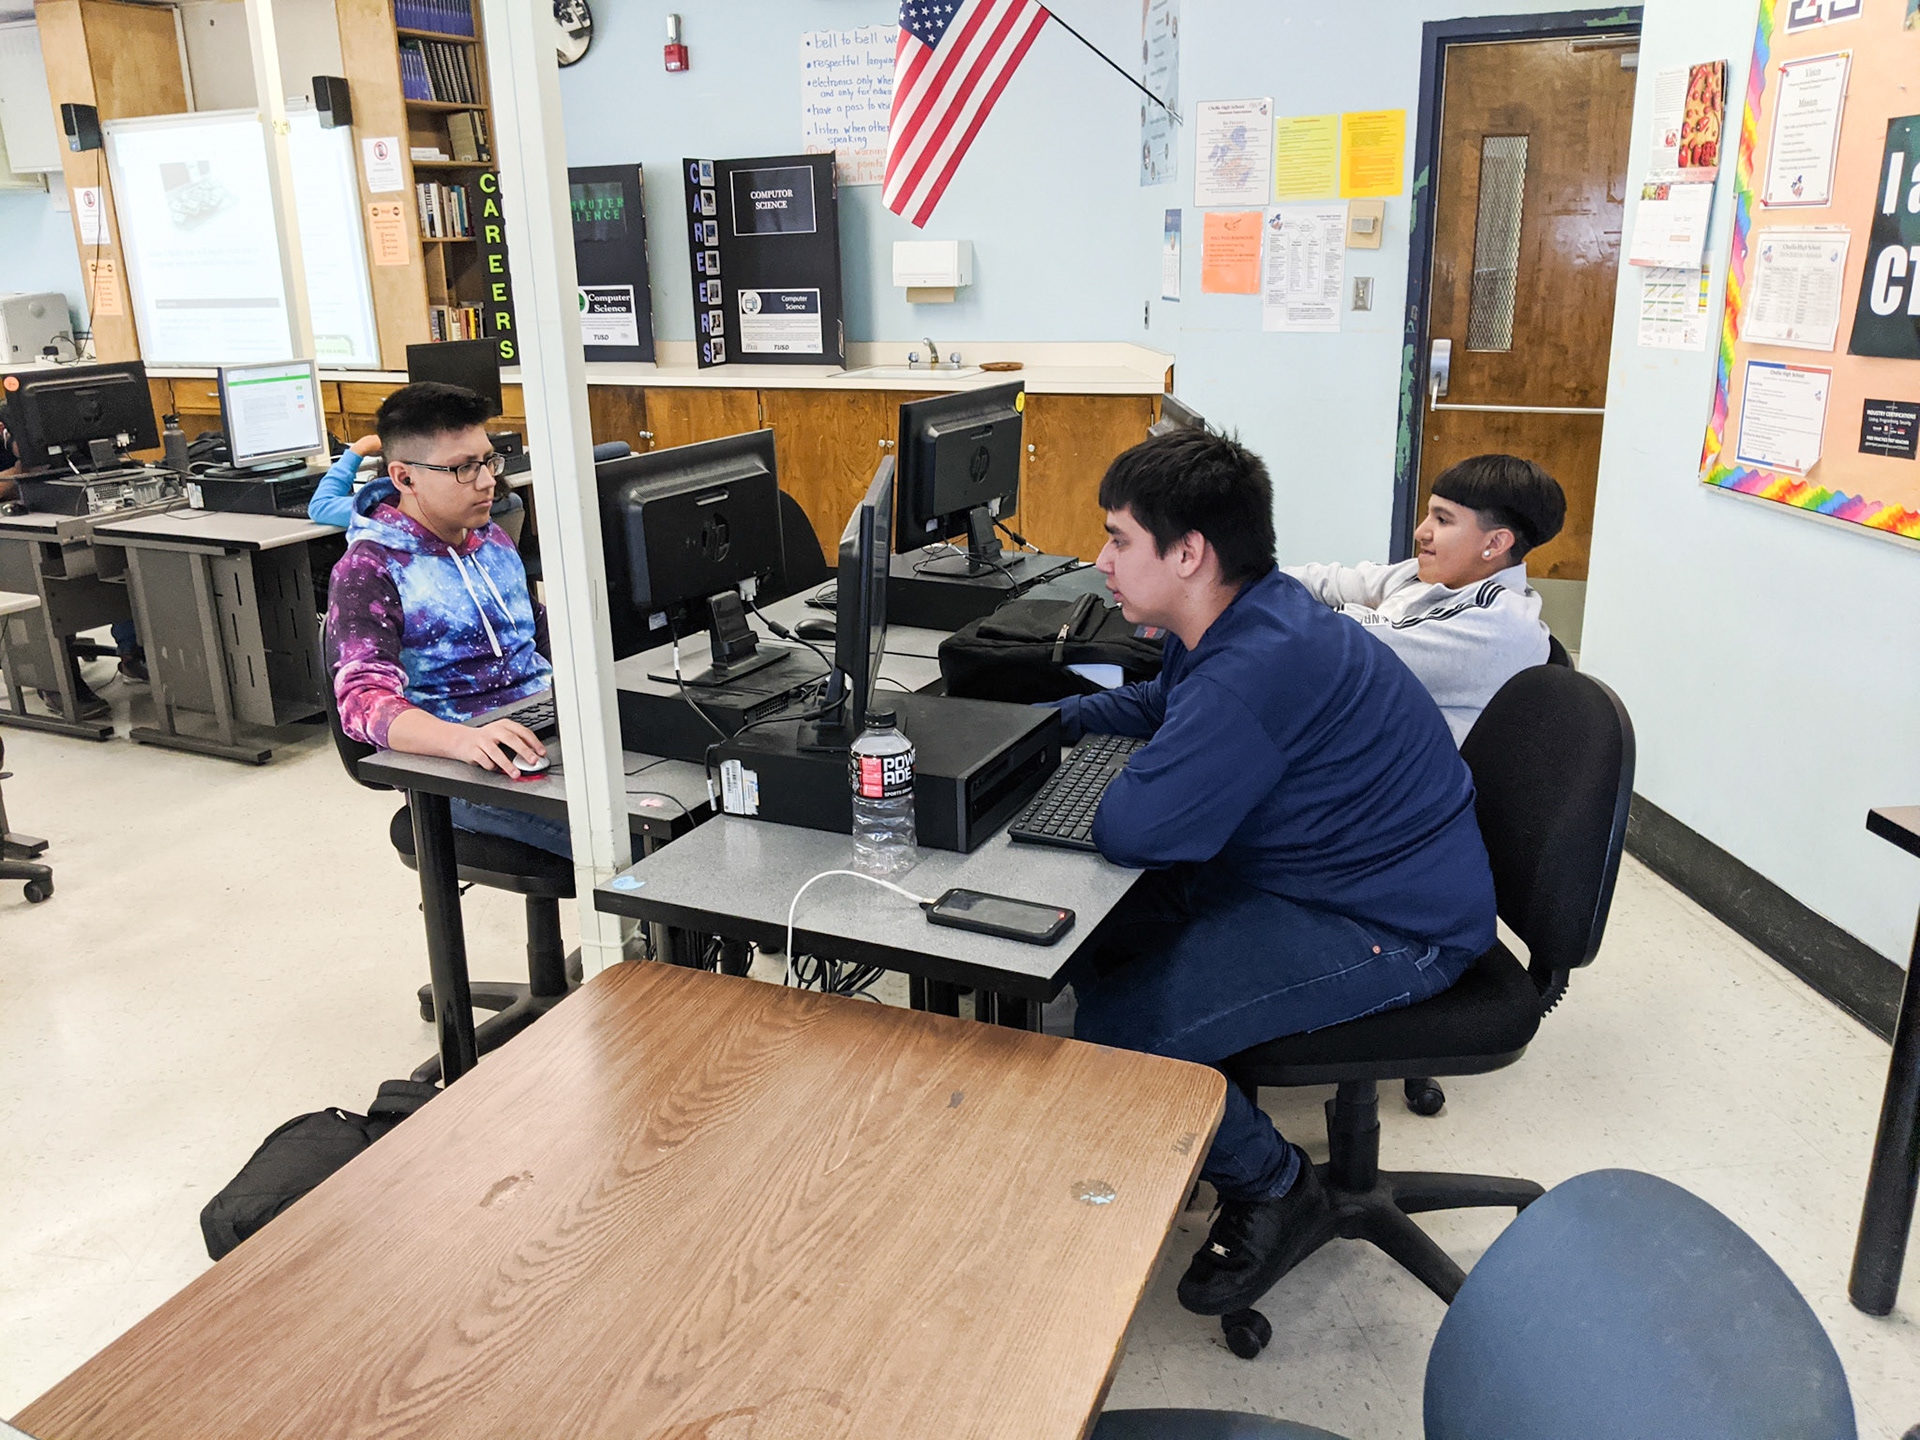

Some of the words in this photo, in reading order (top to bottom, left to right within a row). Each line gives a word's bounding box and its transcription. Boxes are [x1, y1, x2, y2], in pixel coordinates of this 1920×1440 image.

[814, 33, 837, 49] bell
[841, 33, 851, 45] to
[855, 30, 878, 44] bell
[813, 55, 859, 72] respectful
[812, 76, 853, 88] electronics
[856, 75, 873, 89] only
[820, 90, 834, 98] and
[839, 88, 853, 101] only
[857, 87, 870, 95] for
[812, 103, 831, 115] have
[845, 104, 864, 119] pass
[868, 97, 875, 110] to
[814, 122, 838, 134] listen
[844, 121, 865, 133] when
[827, 135, 867, 149] speaking
[750, 189, 793, 199] COMPUTOR
[755, 201, 788, 210] SCIENCE
[479, 173, 515, 359] CAREERS
[689, 162, 712, 363] CAREERS
[588, 293, 631, 304] Computer
[781, 295, 808, 303] Computer
[594, 304, 627, 312] Science
[883, 766, 912, 786] ADE
